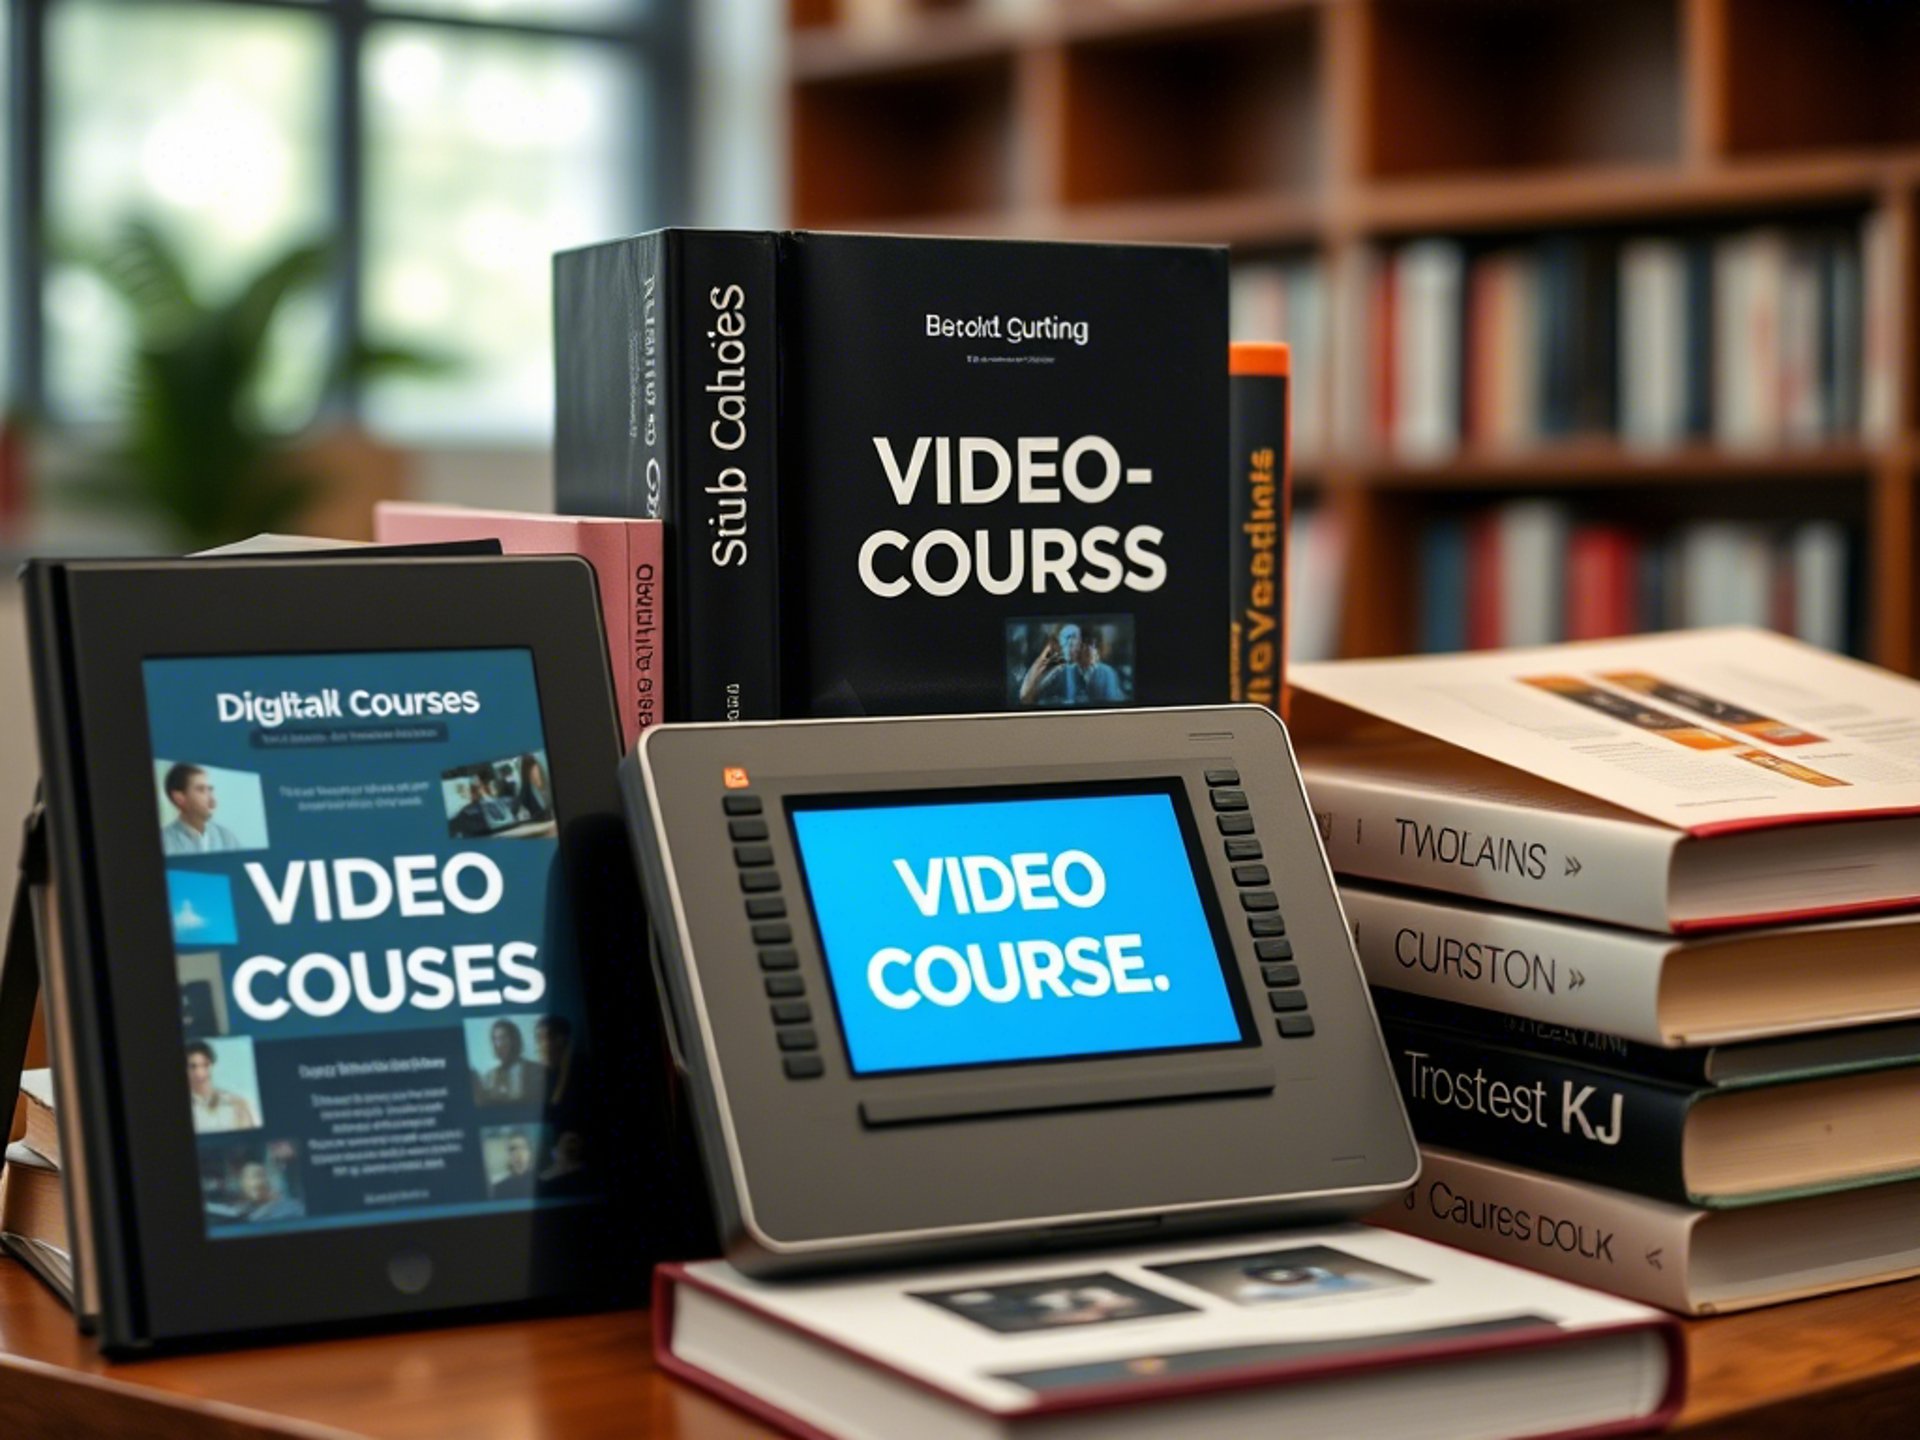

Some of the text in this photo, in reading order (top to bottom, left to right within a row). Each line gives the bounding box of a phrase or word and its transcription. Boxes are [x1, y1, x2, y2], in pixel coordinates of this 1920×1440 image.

[873, 435, 1152, 505] VIDEO-
[858, 525, 1168, 598] COURSS
[350, 689, 481, 717] Courses
[245, 852, 504, 924] VIDEO
[893, 849, 1107, 917] VIDEO
[232, 941, 546, 1020] COUSES
[867, 933, 1171, 1010] COURSE.
[1395, 927, 1556, 994] CURSTON
[1404, 1050, 1624, 1145] Trostest KJ
